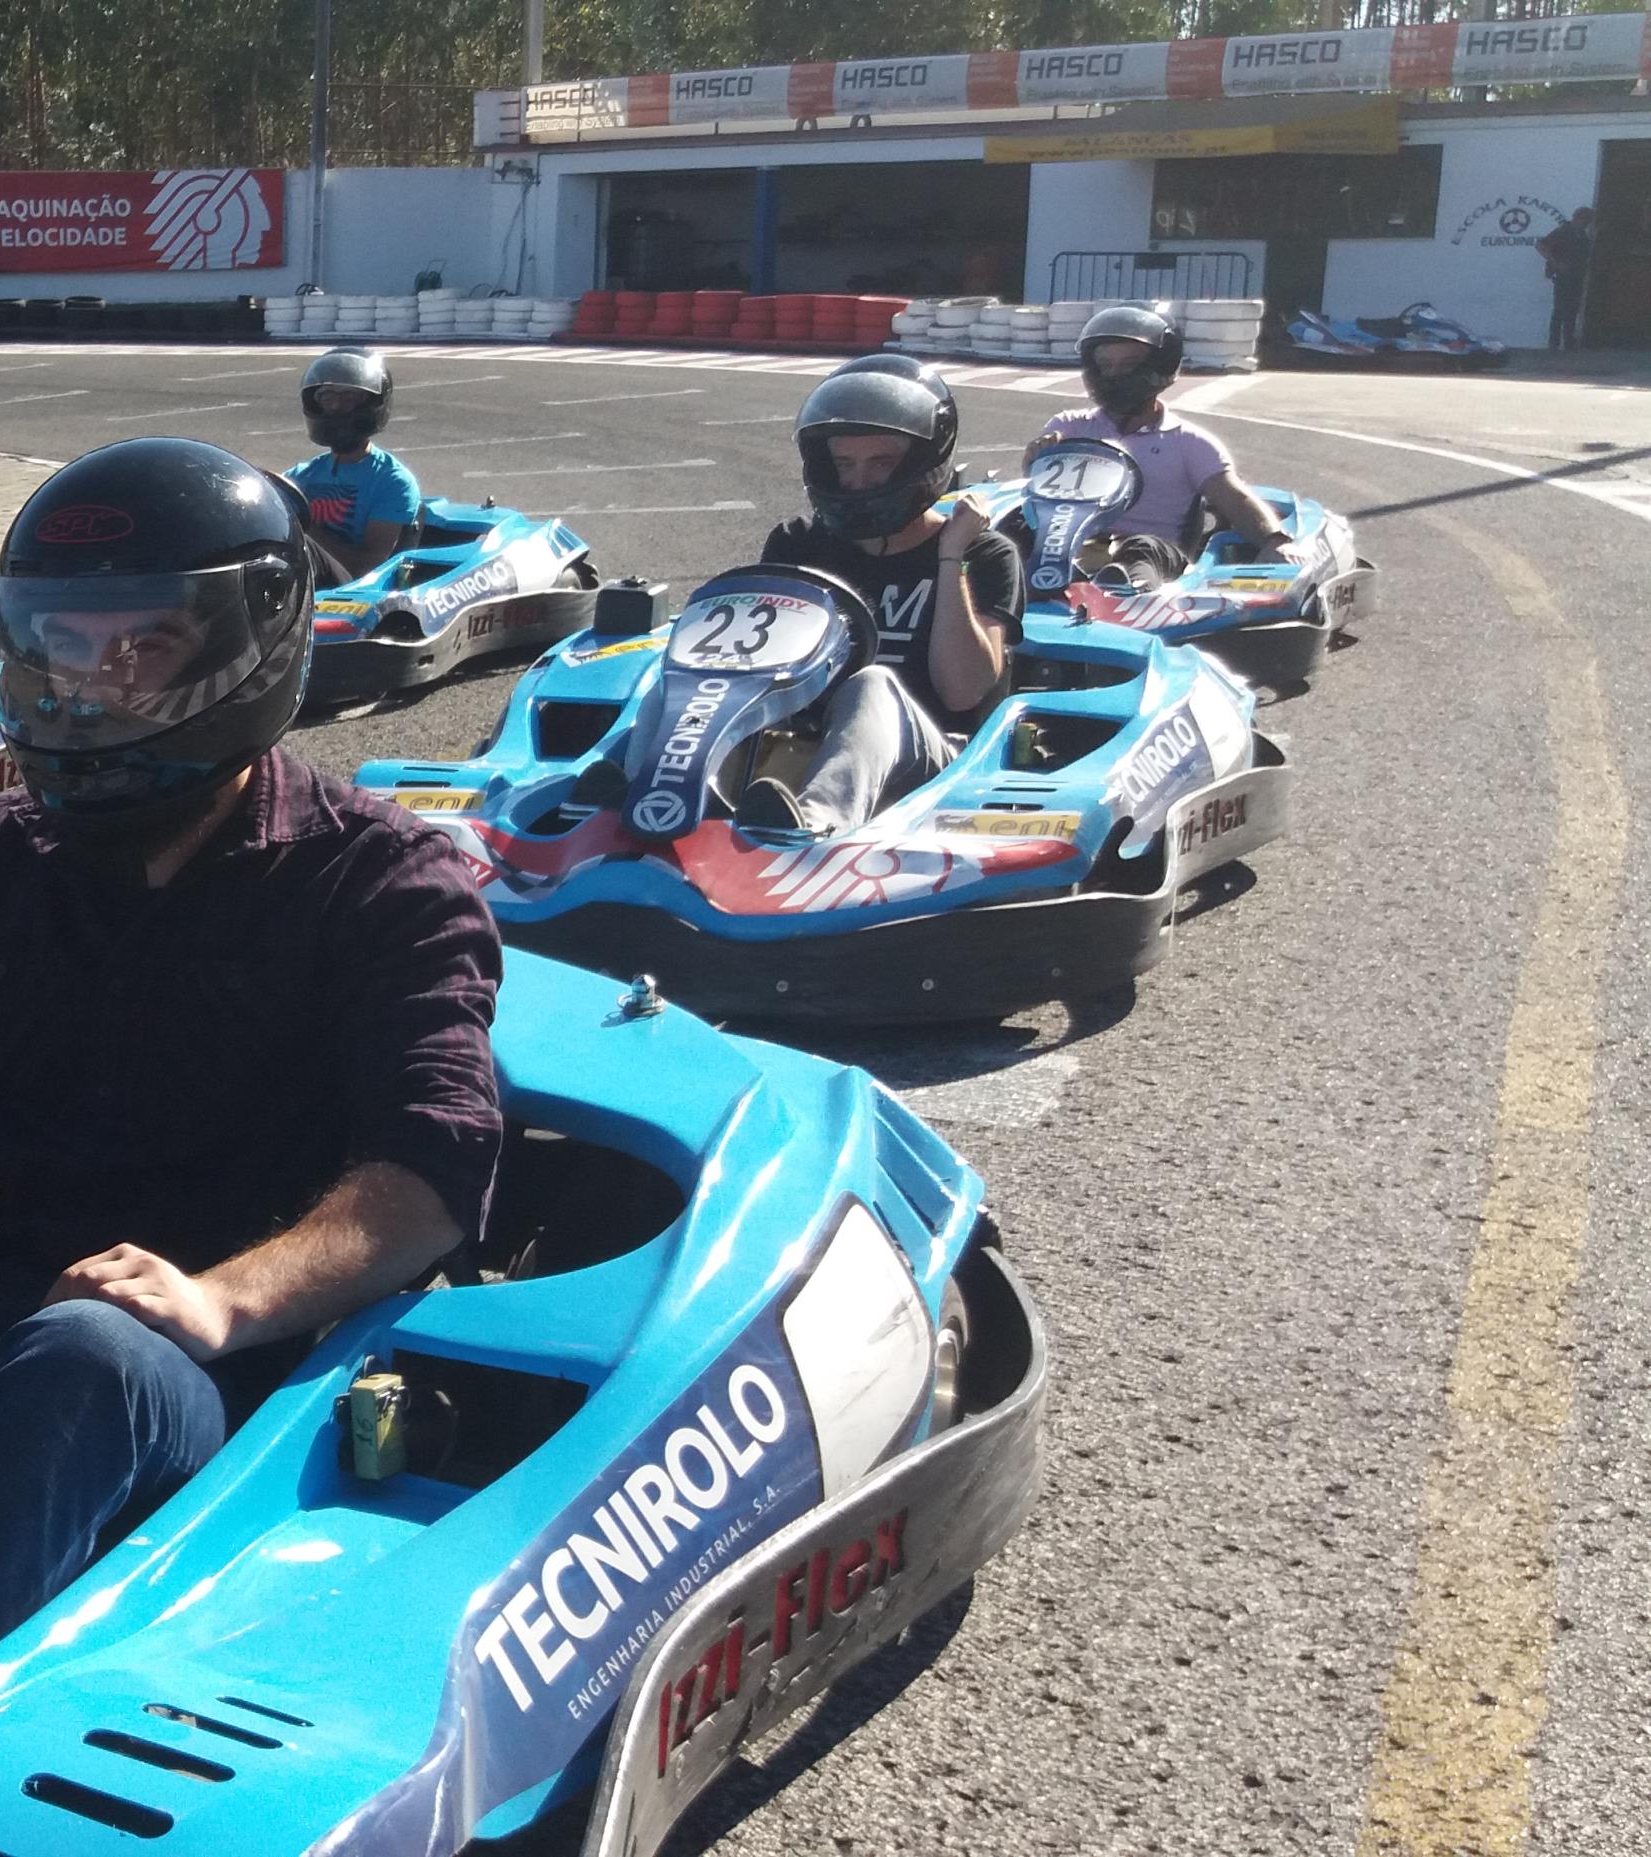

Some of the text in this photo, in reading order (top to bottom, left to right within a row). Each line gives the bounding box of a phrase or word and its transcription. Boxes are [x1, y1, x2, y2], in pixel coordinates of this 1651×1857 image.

[1232, 39, 1342, 68] HASCO
[1466, 25, 1588, 55] HASCO
[841, 64, 928, 90] HASCO
[1025, 53, 1124, 80] HASCO
[526, 87, 597, 111] HASCO
[676, 76, 753, 100] HASCO
[1039, 460, 1088, 490] 21
[1040, 504, 1075, 565] TECNOLO
[424, 561, 509, 618] TECNIROLO
[700, 593, 810, 610] EUROINDY
[689, 604, 777, 655] 23
[409, 794, 475, 811] eni
[988, 815, 1073, 839] eni
[475, 1363, 787, 1713] TECNIROLO
[566, 1484, 781, 1721] ENGENHARIA INDUSTRIAL, S.A.
[657, 1507, 909, 1780] Izzi-Flex
